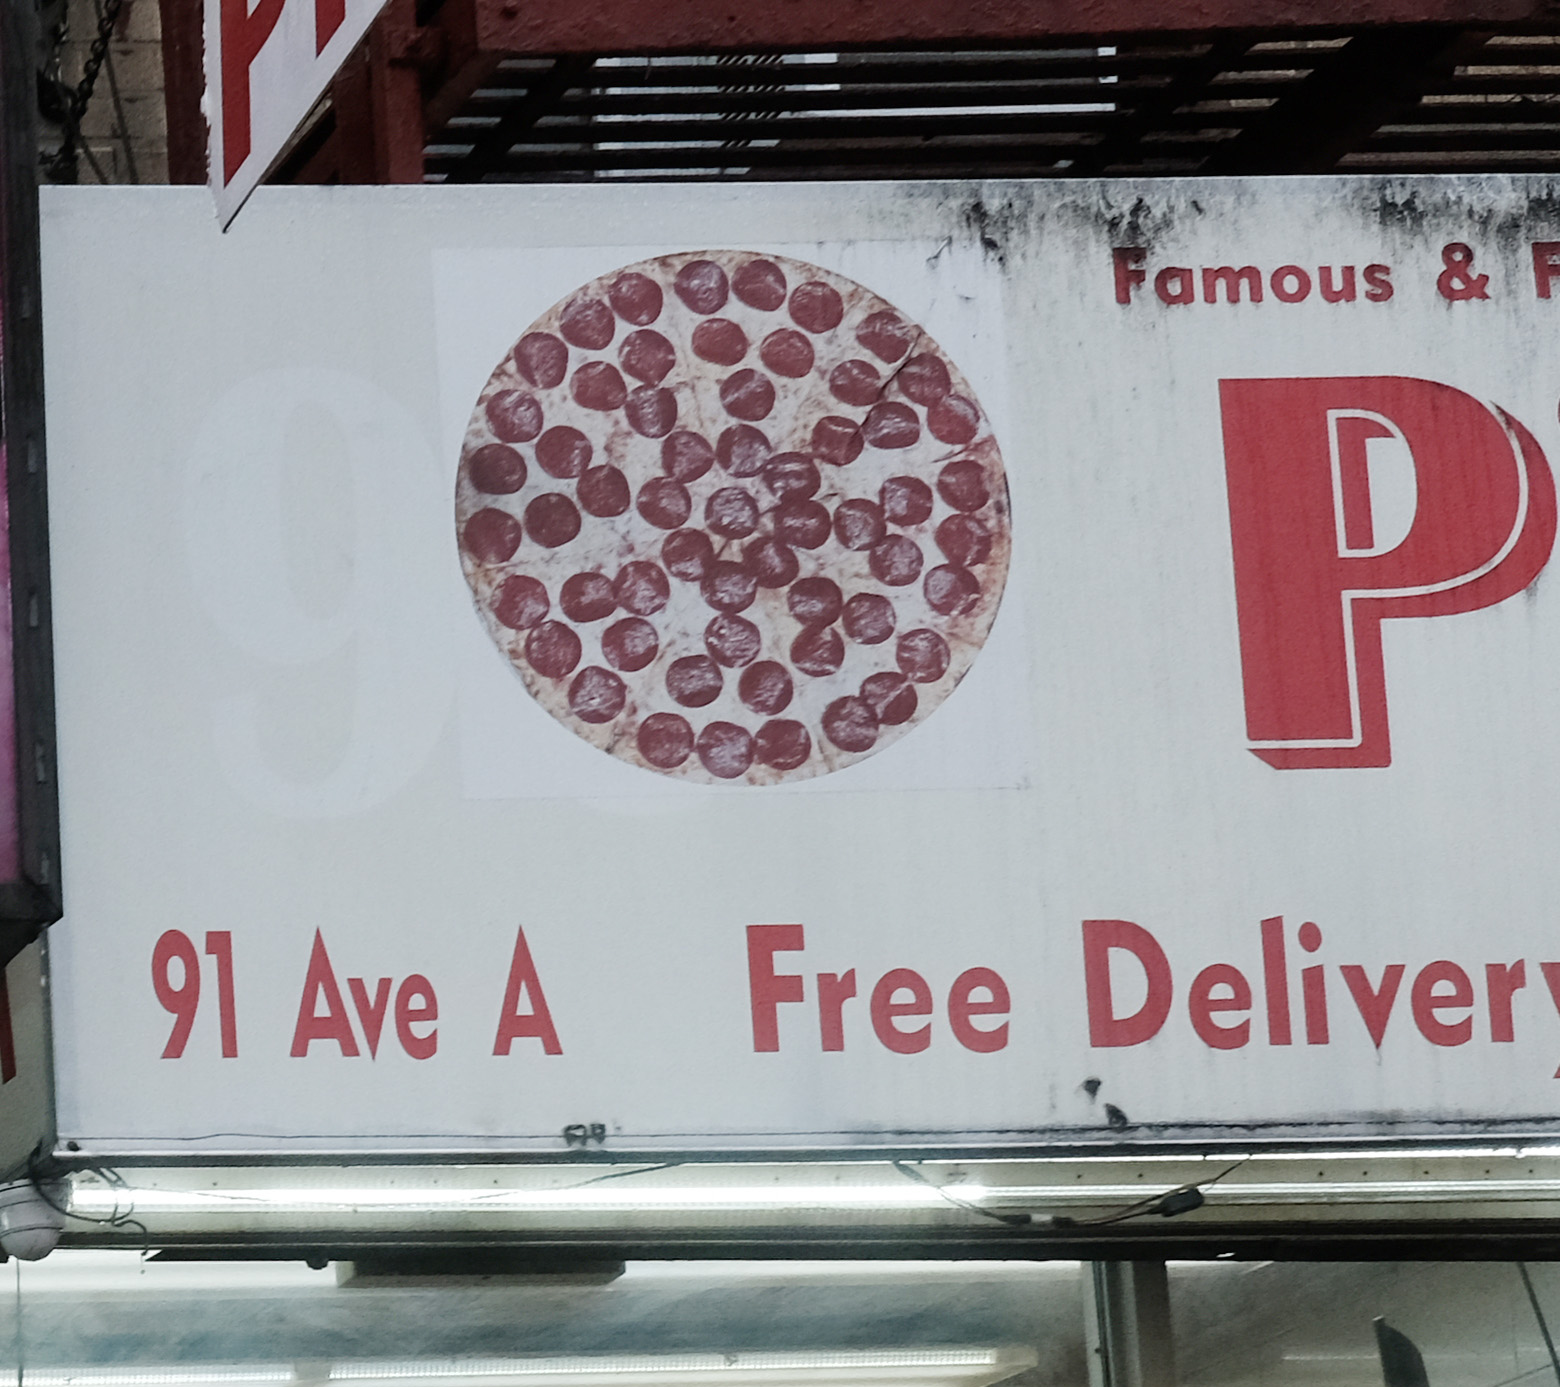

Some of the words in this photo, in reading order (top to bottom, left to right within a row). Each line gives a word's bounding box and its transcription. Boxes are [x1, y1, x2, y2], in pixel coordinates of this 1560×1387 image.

[1113, 247, 1394, 305] Famous
[1436, 242, 1490, 301] &
[152, 929, 238, 1060] 91
[290, 926, 439, 1062] Ave
[492, 925, 564, 1056] A
[746, 923, 1012, 1054] Free
